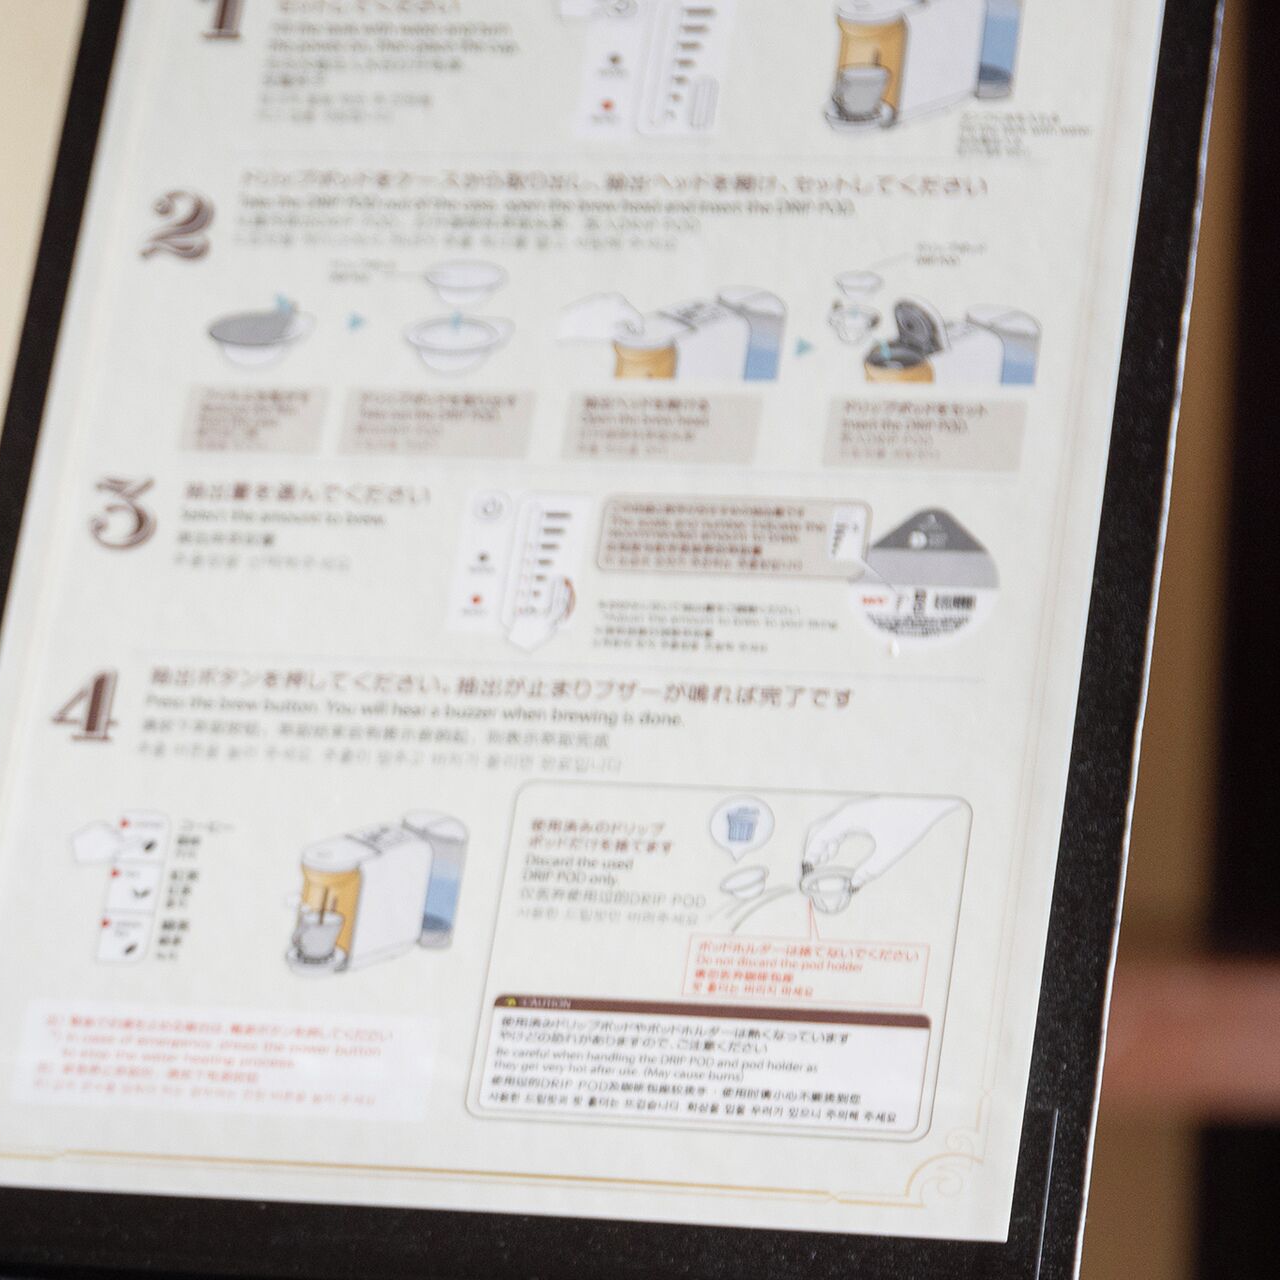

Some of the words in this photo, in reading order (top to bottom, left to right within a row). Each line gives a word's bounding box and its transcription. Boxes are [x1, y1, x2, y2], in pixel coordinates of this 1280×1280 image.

[141, 190, 215, 262] 2
[89, 474, 158, 551] 3
[50, 668, 119, 744] 4
[525, 853, 574, 869] Discard
[577, 855, 598, 869] the
[602, 857, 635, 871] used
[522, 868, 553, 882] DRIP
[556, 870, 587, 884] POD
[696, 954, 713, 967] Do
[715, 956, 734, 968] not
[737, 956, 777, 969] discard
[780, 957, 798, 970] the
[800, 959, 825, 973] pod
[827, 961, 864, 973] holder
[493, 1059, 518, 1074] they
[520, 1061, 539, 1074] get
[541, 1063, 565, 1076] very
[567, 1062, 588, 1074] hot
[589, 1063, 616, 1075] after
[643, 1066, 671, 1080] (May
[673, 1069, 705, 1080] cause
[707, 1070, 745, 1084] burns)
[513, 1047, 549, 1060] careful
[553, 1050, 585, 1061] when
[587, 1051, 636, 1066] handling
[639, 1053, 658, 1065] the
[660, 1053, 687, 1066] DRIP
[688, 1055, 715, 1067] POD
[717, 1056, 740, 1069] and
[741, 1058, 764, 1073] pod
[766, 1059, 804, 1073] holder
[806, 1063, 819, 1073] as
